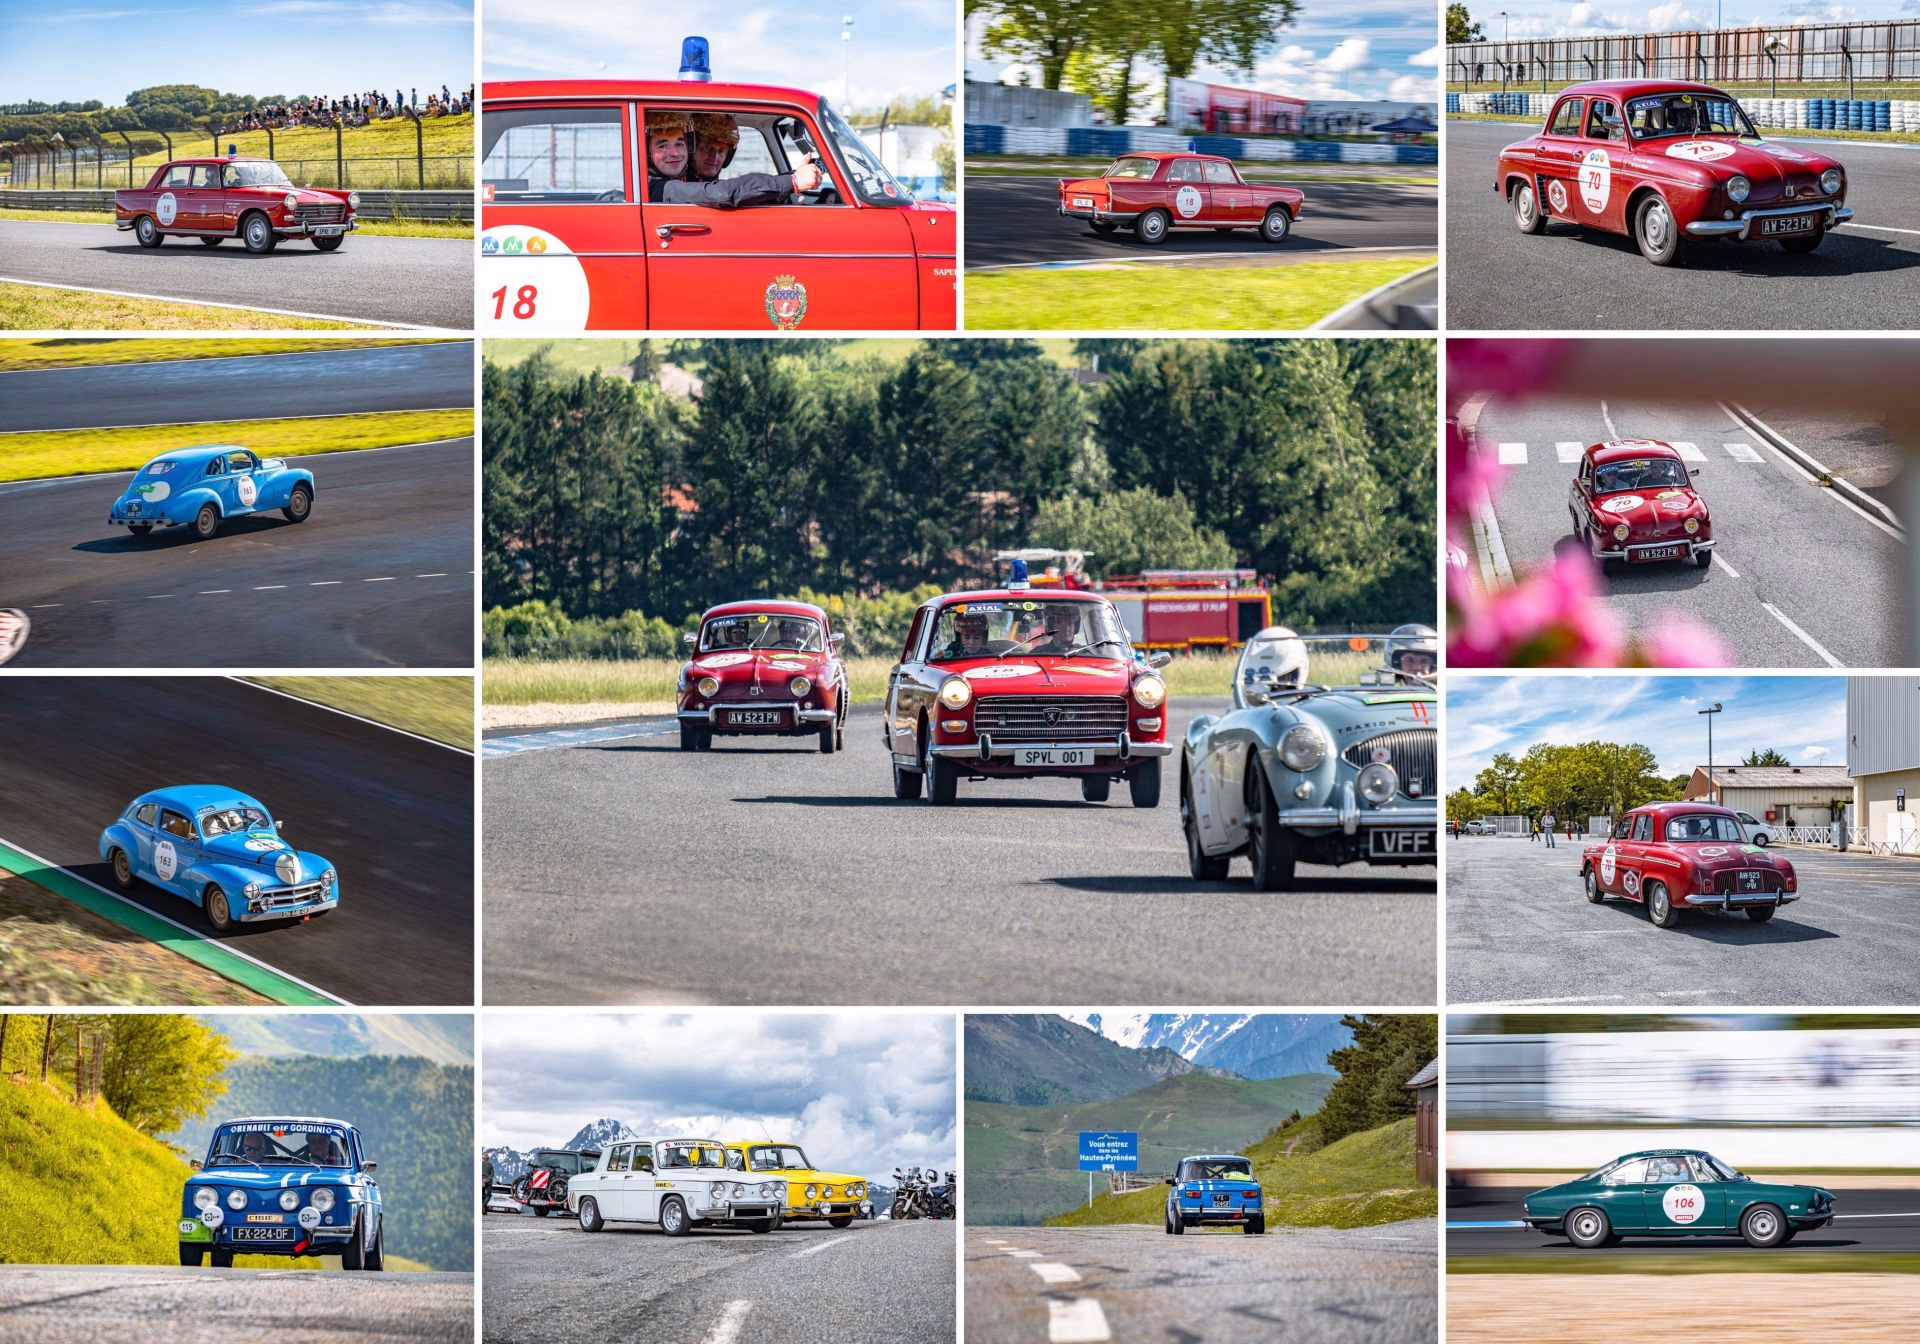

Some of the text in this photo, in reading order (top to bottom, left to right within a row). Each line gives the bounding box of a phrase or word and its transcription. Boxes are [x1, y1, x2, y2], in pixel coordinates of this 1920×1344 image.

[1635, 101, 1659, 109] AXIAL
[1687, 145, 1714, 155] 70
[1588, 171, 1601, 190] 70
[1185, 198, 1194, 206] 18
[163, 204, 171, 213] 18
[1764, 216, 1812, 233] AW 523 PW
[491, 284, 538, 320] 18
[1652, 549, 1666, 557] 523
[968, 605, 1001, 613] AXIAL
[731, 712, 778, 723] AW 523 PW
[1337, 720, 1396, 735] TRAXION
[1025, 751, 1084, 763] SPVL 001
[1382, 832, 1429, 853] VFF
[160, 855, 171, 867] 163
[237, 1124, 270, 1132] RENAULT
[290, 1124, 325, 1133] GORDINI
[1080, 1154, 1137, 1162] Hautes-Pyrénées
[1674, 1199, 1694, 1208] 106
[181, 1222, 193, 1232] 115
[238, 1229, 289, 1240] FX-224-DF
